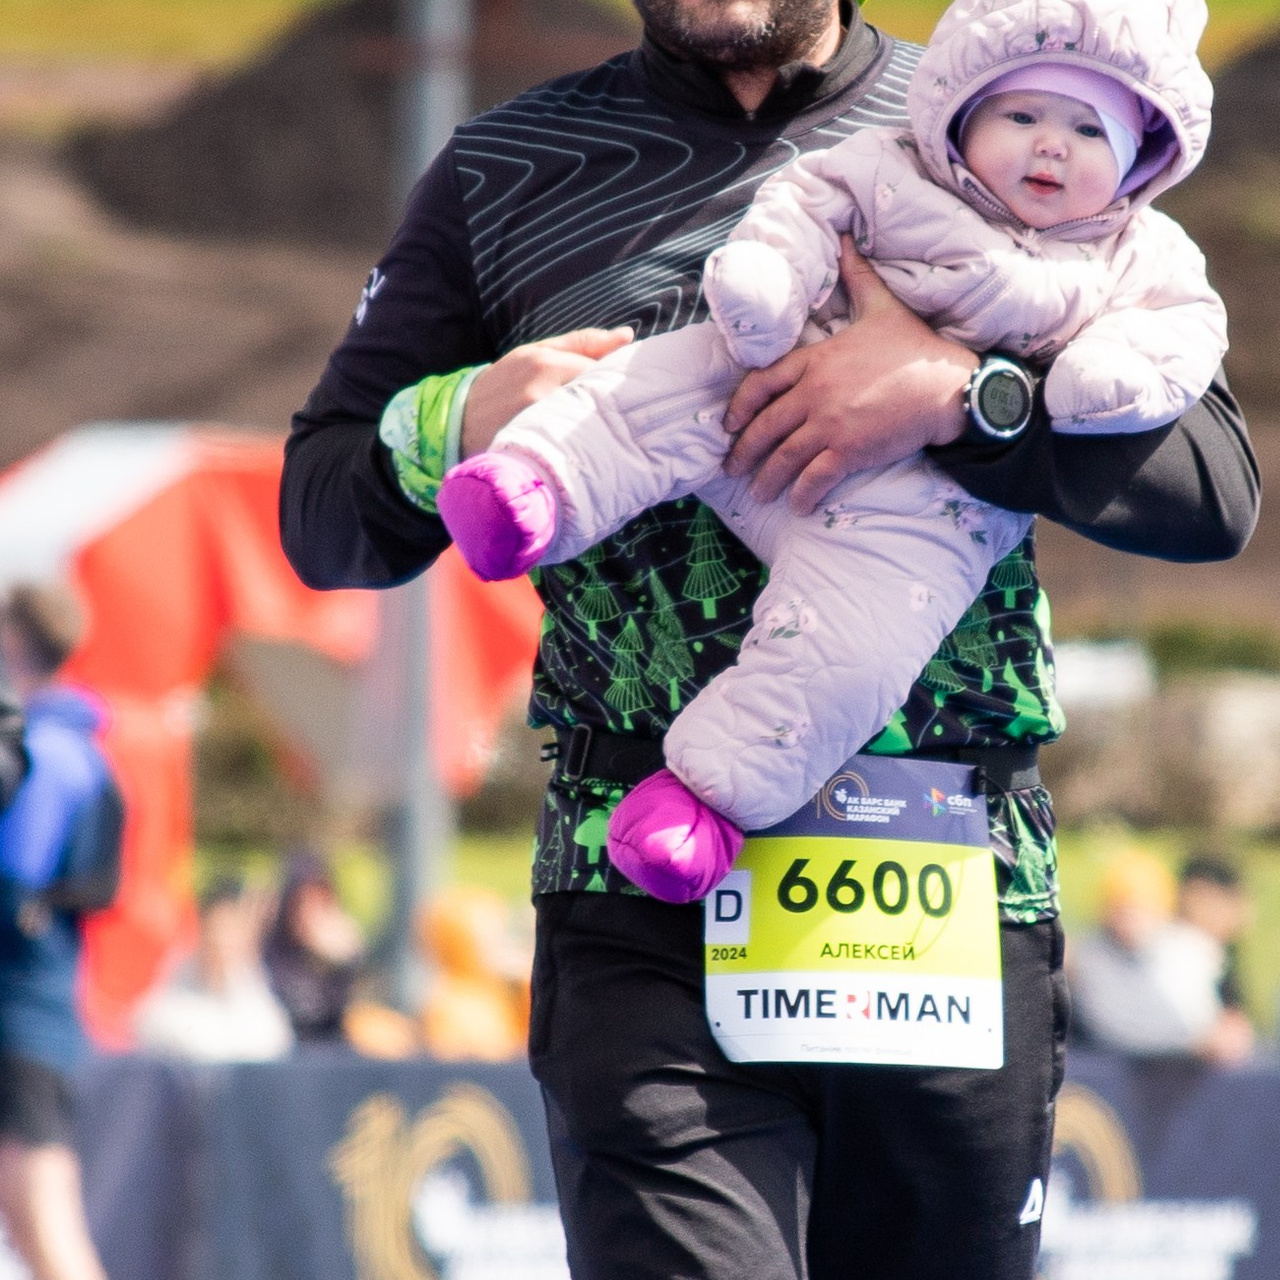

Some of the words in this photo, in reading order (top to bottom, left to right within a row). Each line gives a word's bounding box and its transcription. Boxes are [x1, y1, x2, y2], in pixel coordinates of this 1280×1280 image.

[776, 857, 954, 919] 6600
[714, 888, 743, 924] D
[711, 946, 748, 961] 2024
[819, 940, 916, 962] АЛЕКСЕЙ
